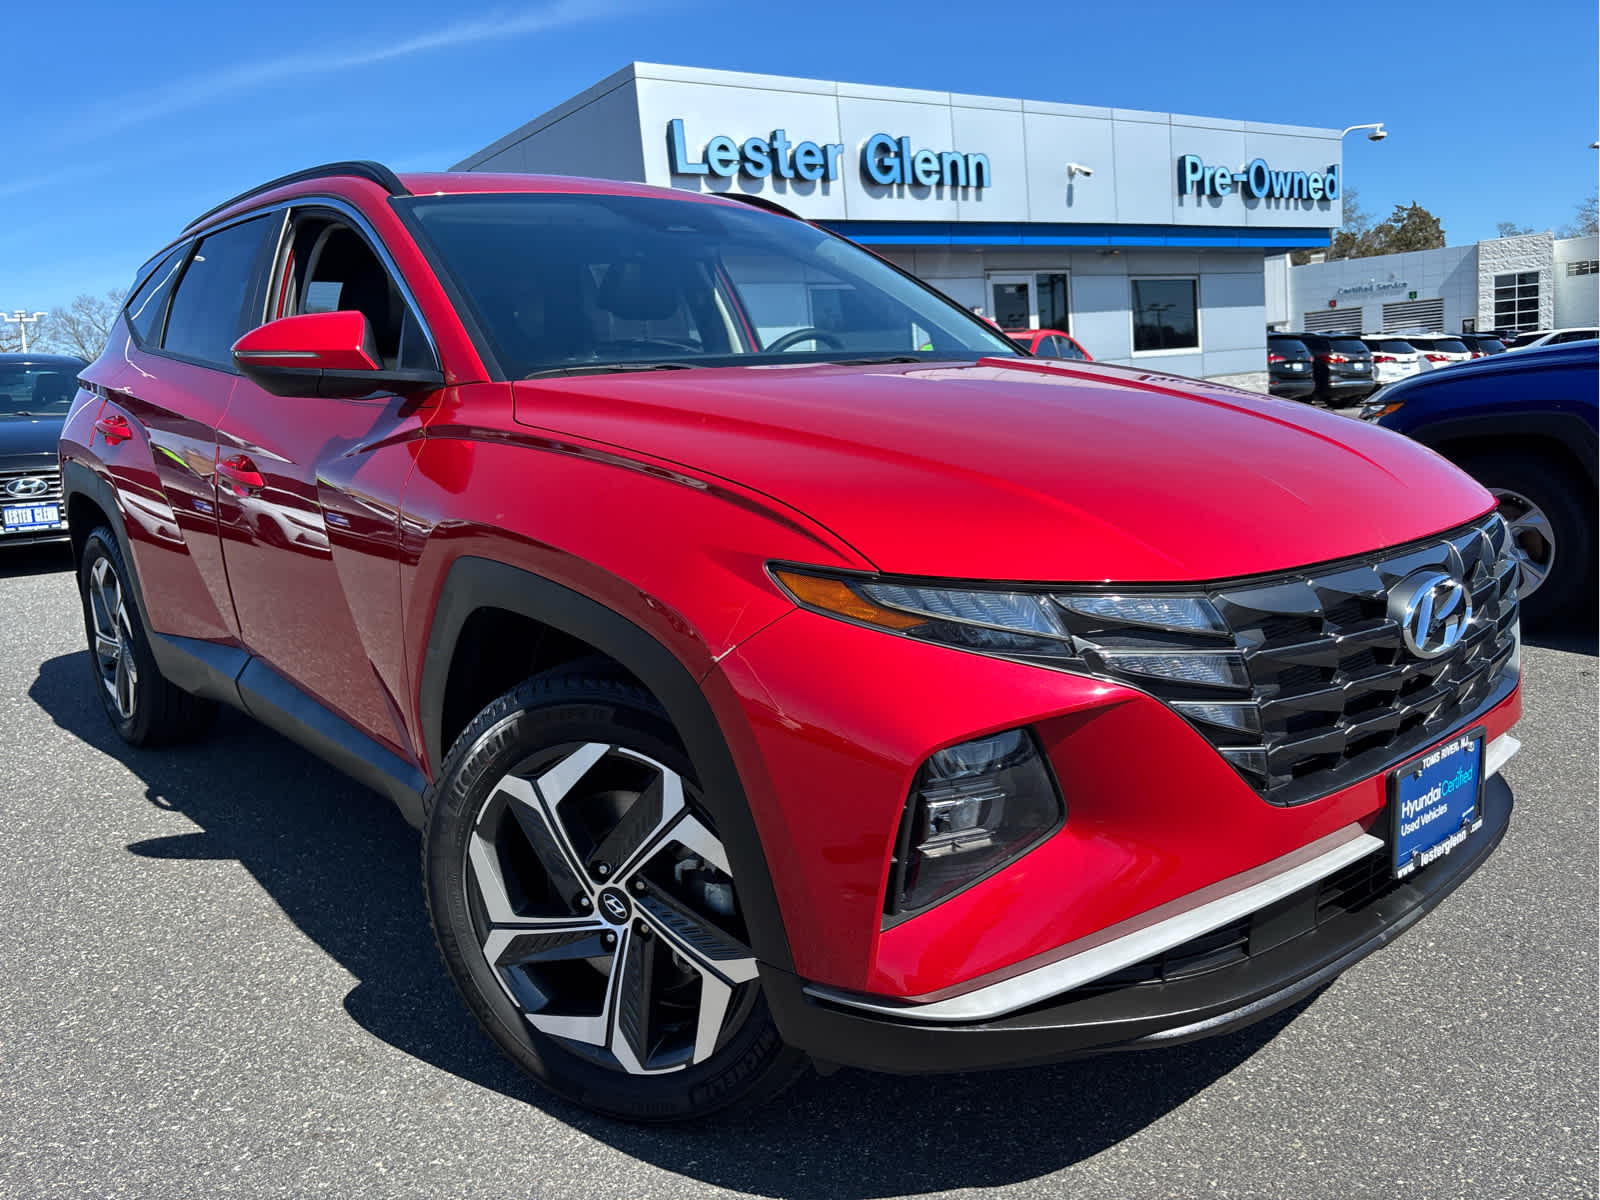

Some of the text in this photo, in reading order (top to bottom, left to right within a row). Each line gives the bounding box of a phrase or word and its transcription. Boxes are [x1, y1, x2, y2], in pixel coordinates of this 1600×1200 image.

[666, 118, 991, 188] Lester Glenn
[1178, 154, 1340, 200] Pre-Owned
[1422, 751, 1441, 769] TOMS
[1401, 803, 1448, 837] Used Vehicles
[1421, 829, 1466, 867] lesterglenn
